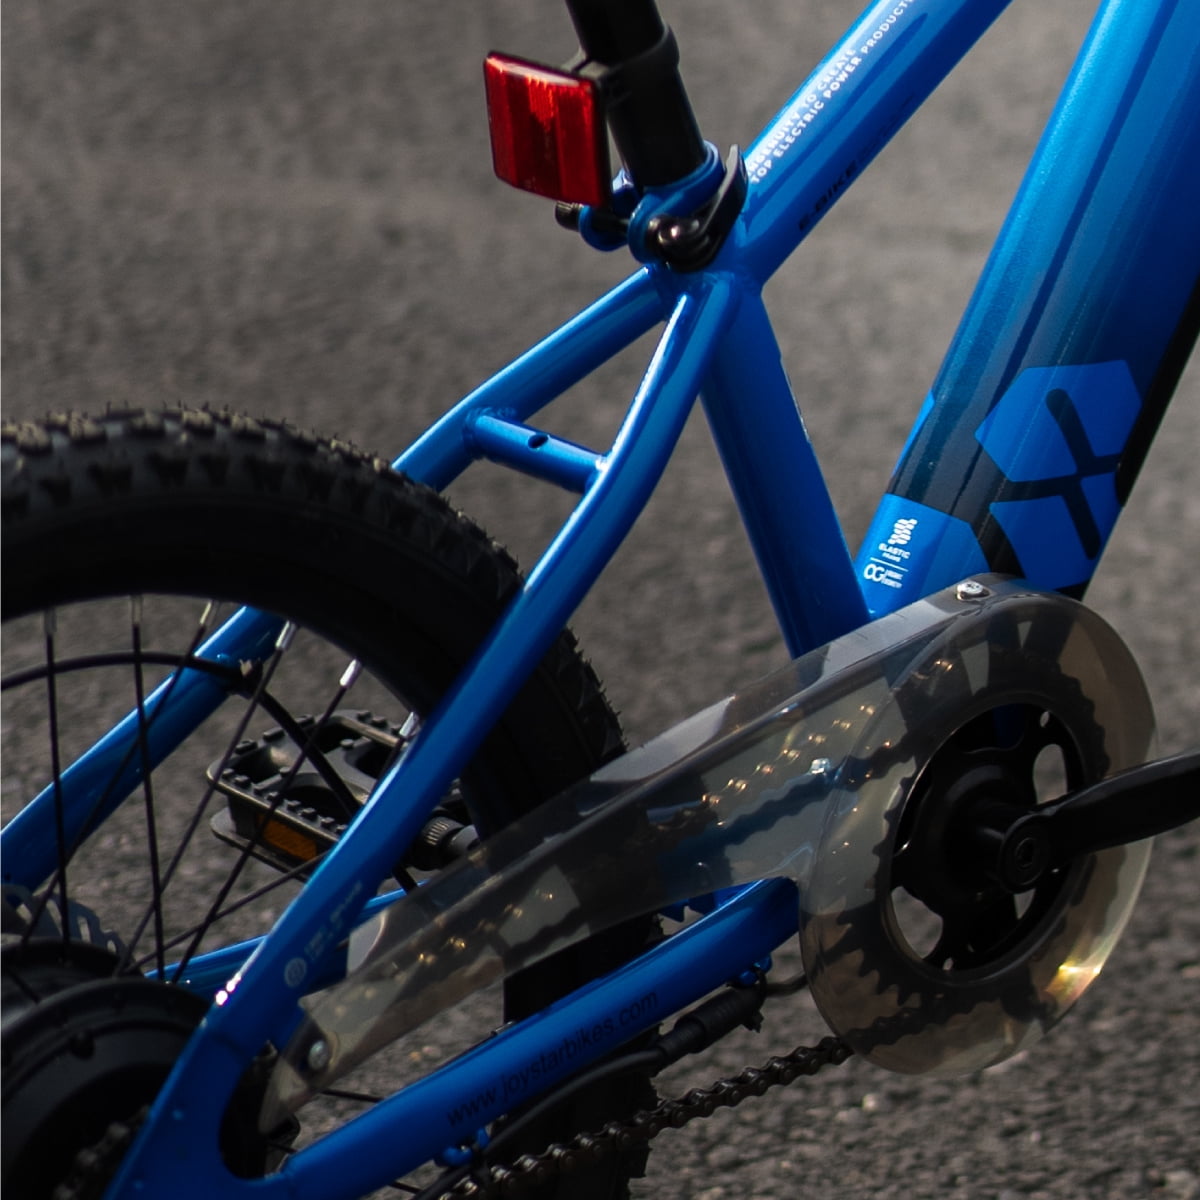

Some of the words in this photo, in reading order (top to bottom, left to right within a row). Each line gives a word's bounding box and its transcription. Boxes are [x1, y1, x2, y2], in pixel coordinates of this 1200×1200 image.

[751, 162, 772, 184] TOP
[773, 100, 824, 158] ELECTRIC
[823, 56, 862, 99] POWER
[801, 93, 817, 109] TO
[817, 49, 856, 91] CREATE
